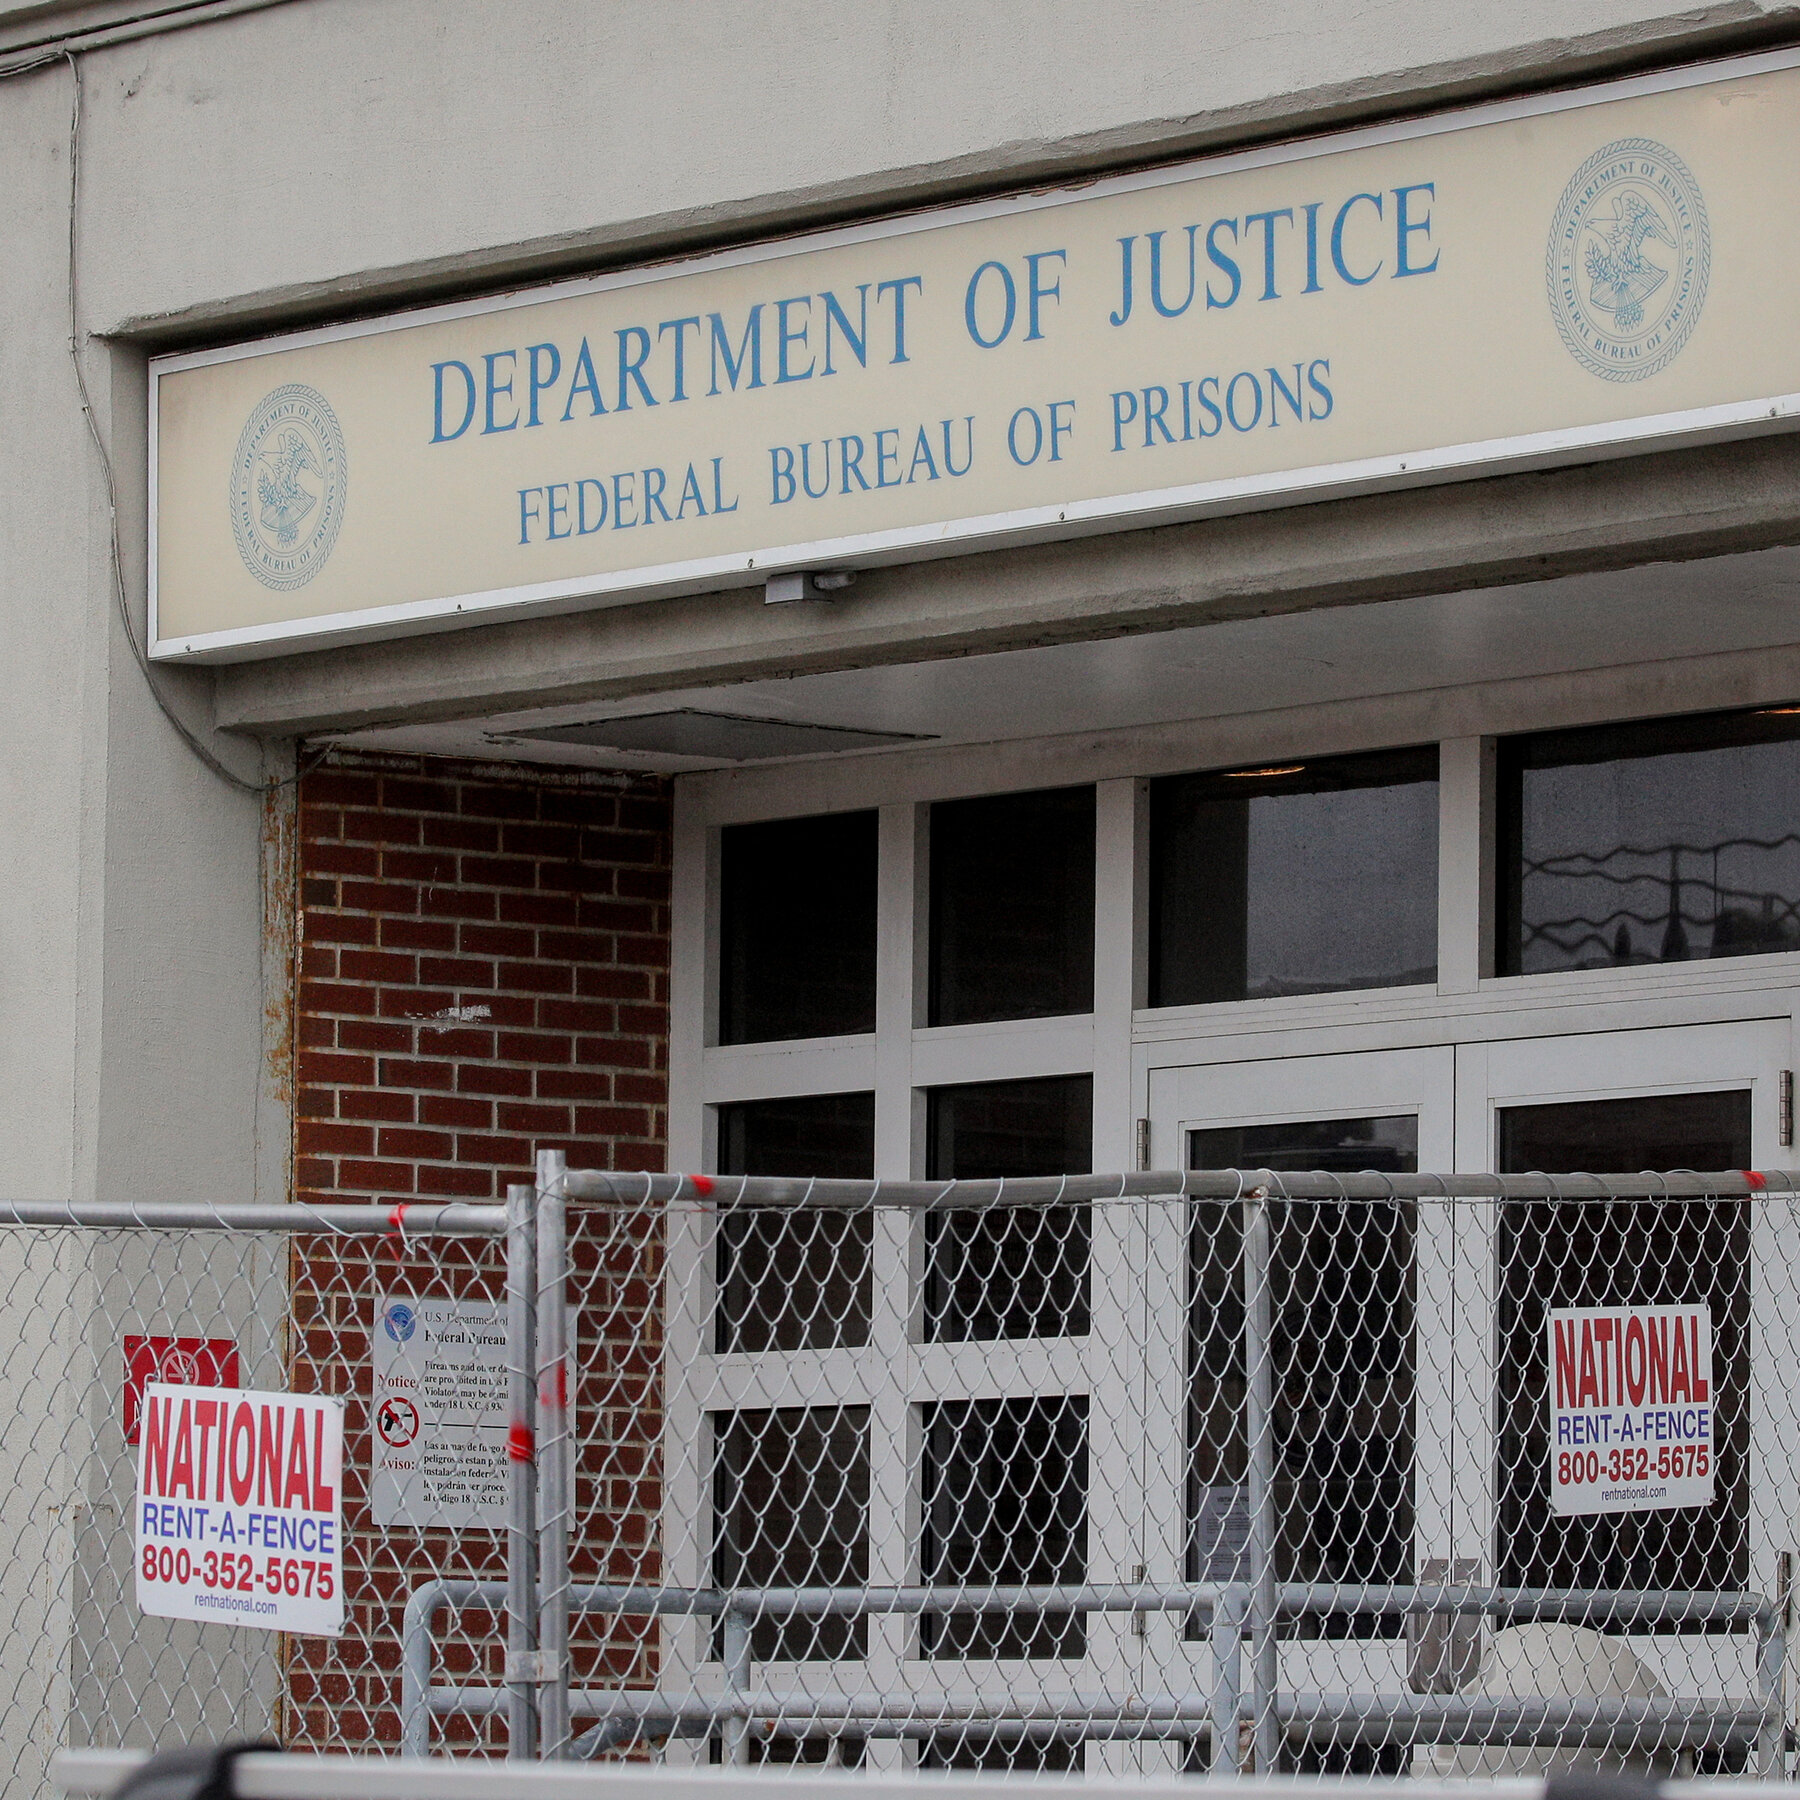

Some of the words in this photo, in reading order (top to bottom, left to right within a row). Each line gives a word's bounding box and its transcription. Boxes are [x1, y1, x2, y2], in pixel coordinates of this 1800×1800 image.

[1564, 160, 1635, 240] DEPARTMENT
[1640, 162, 1657, 178] OF
[1658, 172, 1692, 232] JUSTICE
[428, 275, 922, 445] DEPARTMENT
[964, 249, 1067, 349] OF
[1109, 181, 1442, 327] JUSTICE
[1561, 265, 1590, 341] FEDERAL
[1594, 339, 1642, 359] BUREAU
[1647, 332, 1662, 350] OF
[1665, 256, 1694, 331] PRISONS
[298, 405, 310, 418] OF
[516, 457, 739, 545] FEDERAL
[769, 416, 976, 505] BUREAU
[1007, 400, 1076, 467] OF
[1109, 359, 1334, 453] PRISONS
[425, 1311, 444, 1323] U.S.
[476, 1364, 496, 1372] oter
[1554, 1315, 1709, 1409] NATIONAL
[424, 1375, 437, 1383] are
[438, 1376, 477, 1386] proibited
[479, 1376, 487, 1384] in
[424, 1387, 456, 1397] Violator
[460, 1390, 476, 1400] may
[478, 1389, 487, 1398] be
[449, 1400, 458, 1409] 18
[1557, 1409, 1710, 1445] RENT-A-FENCE
[143, 1396, 333, 1513] NATIONAL
[467, 1442, 477, 1452] de
[479, 1443, 501, 1453] fugo
[424, 1454, 464, 1464] peligross
[1557, 1445, 1709, 1485] 800-352-5675
[423, 1493, 431, 1501] al
[433, 1493, 458, 1505] cdigo
[461, 1495, 470, 1503] 18
[1601, 1486, 1667, 1501] rentnational.com
[143, 1503, 335, 1554] RENT-A-FENCE
[142, 1544, 335, 1600] 800-352-5675
[194, 1593, 278, 1615] rentnational.com
